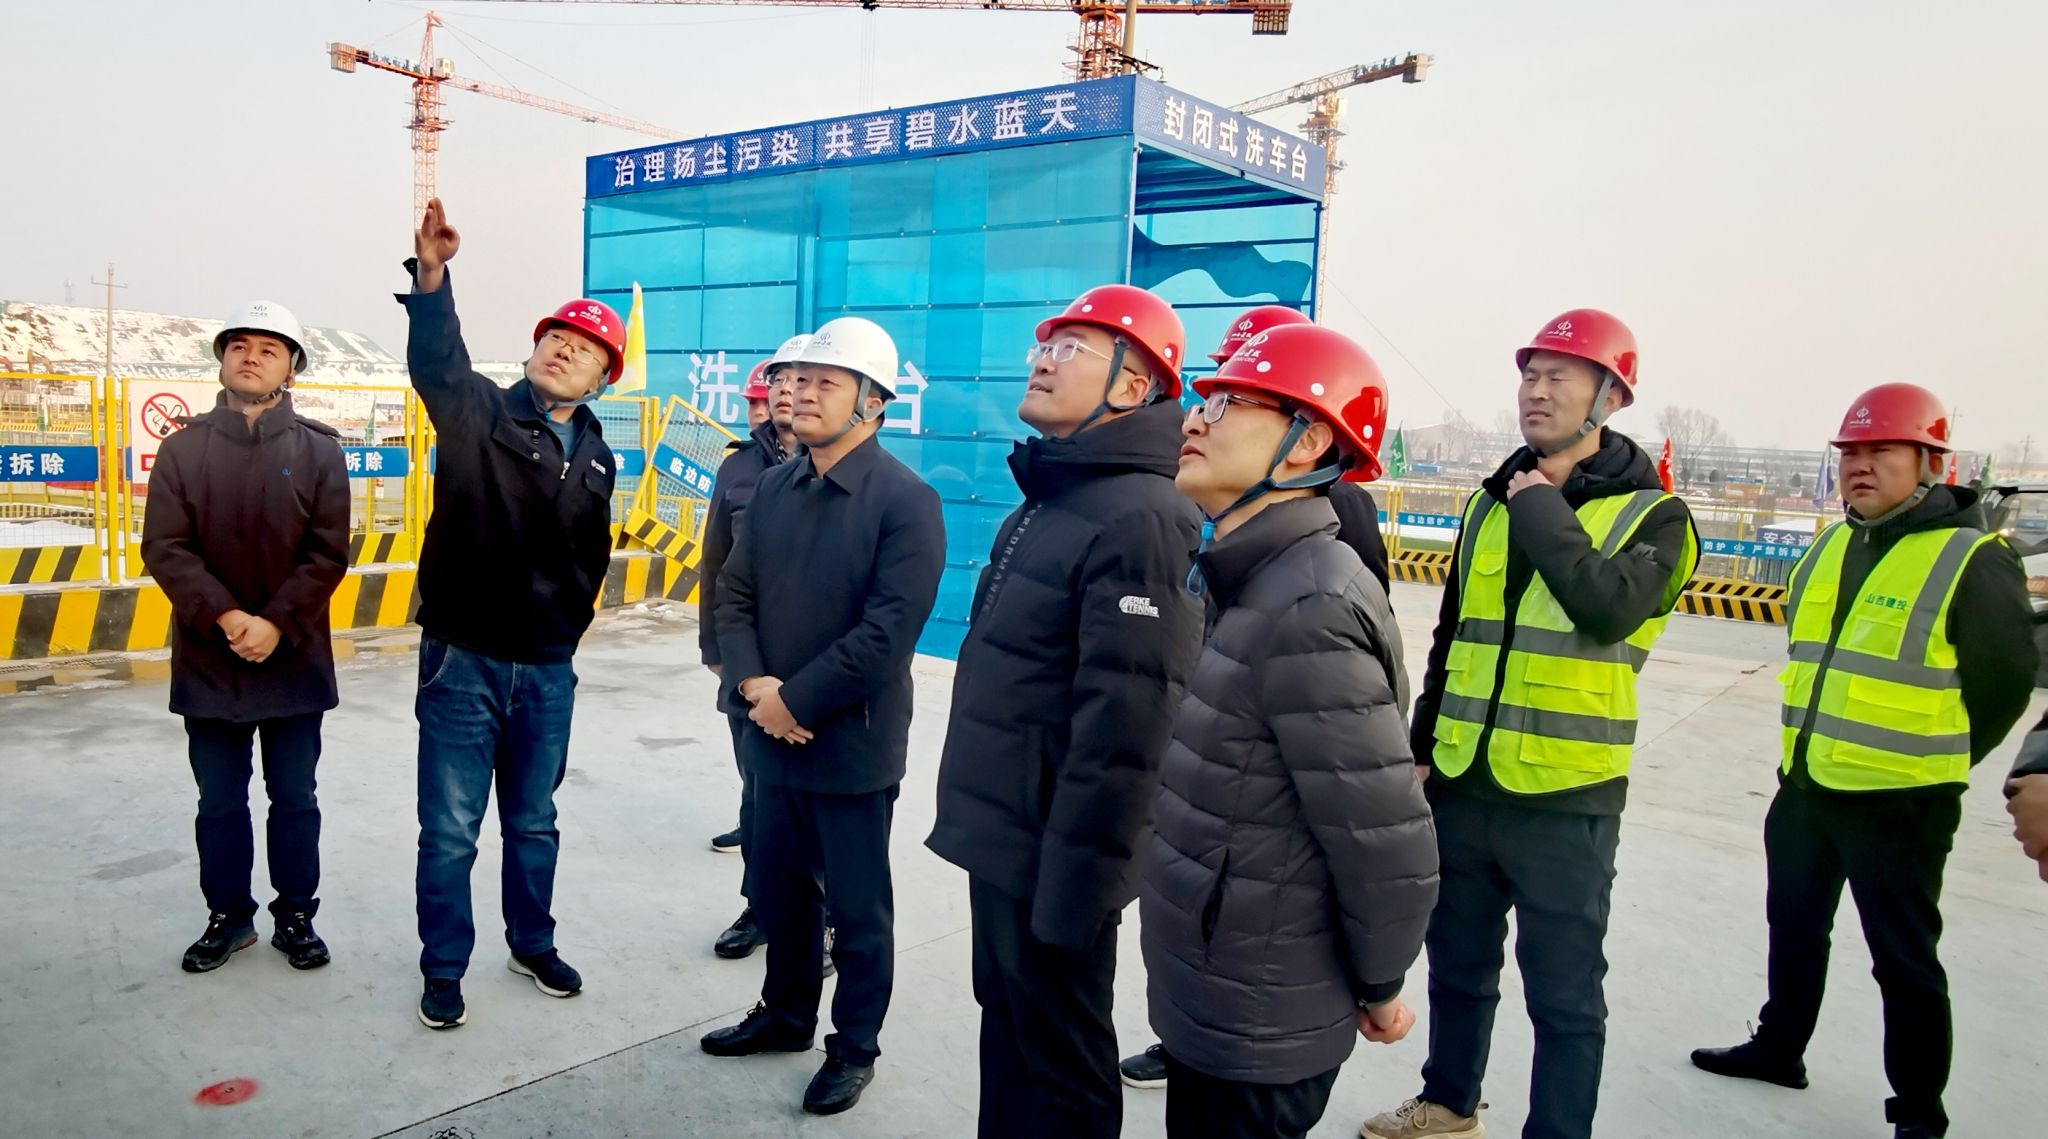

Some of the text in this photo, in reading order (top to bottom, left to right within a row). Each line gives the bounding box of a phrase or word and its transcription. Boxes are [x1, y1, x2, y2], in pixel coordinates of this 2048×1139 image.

[614, 91, 1078, 187] 治理扬尘污染 共享碧水蓝天
[1163, 95, 1308, 182] 封闭式洗车台
[0, 452, 65, 476] 拆除
